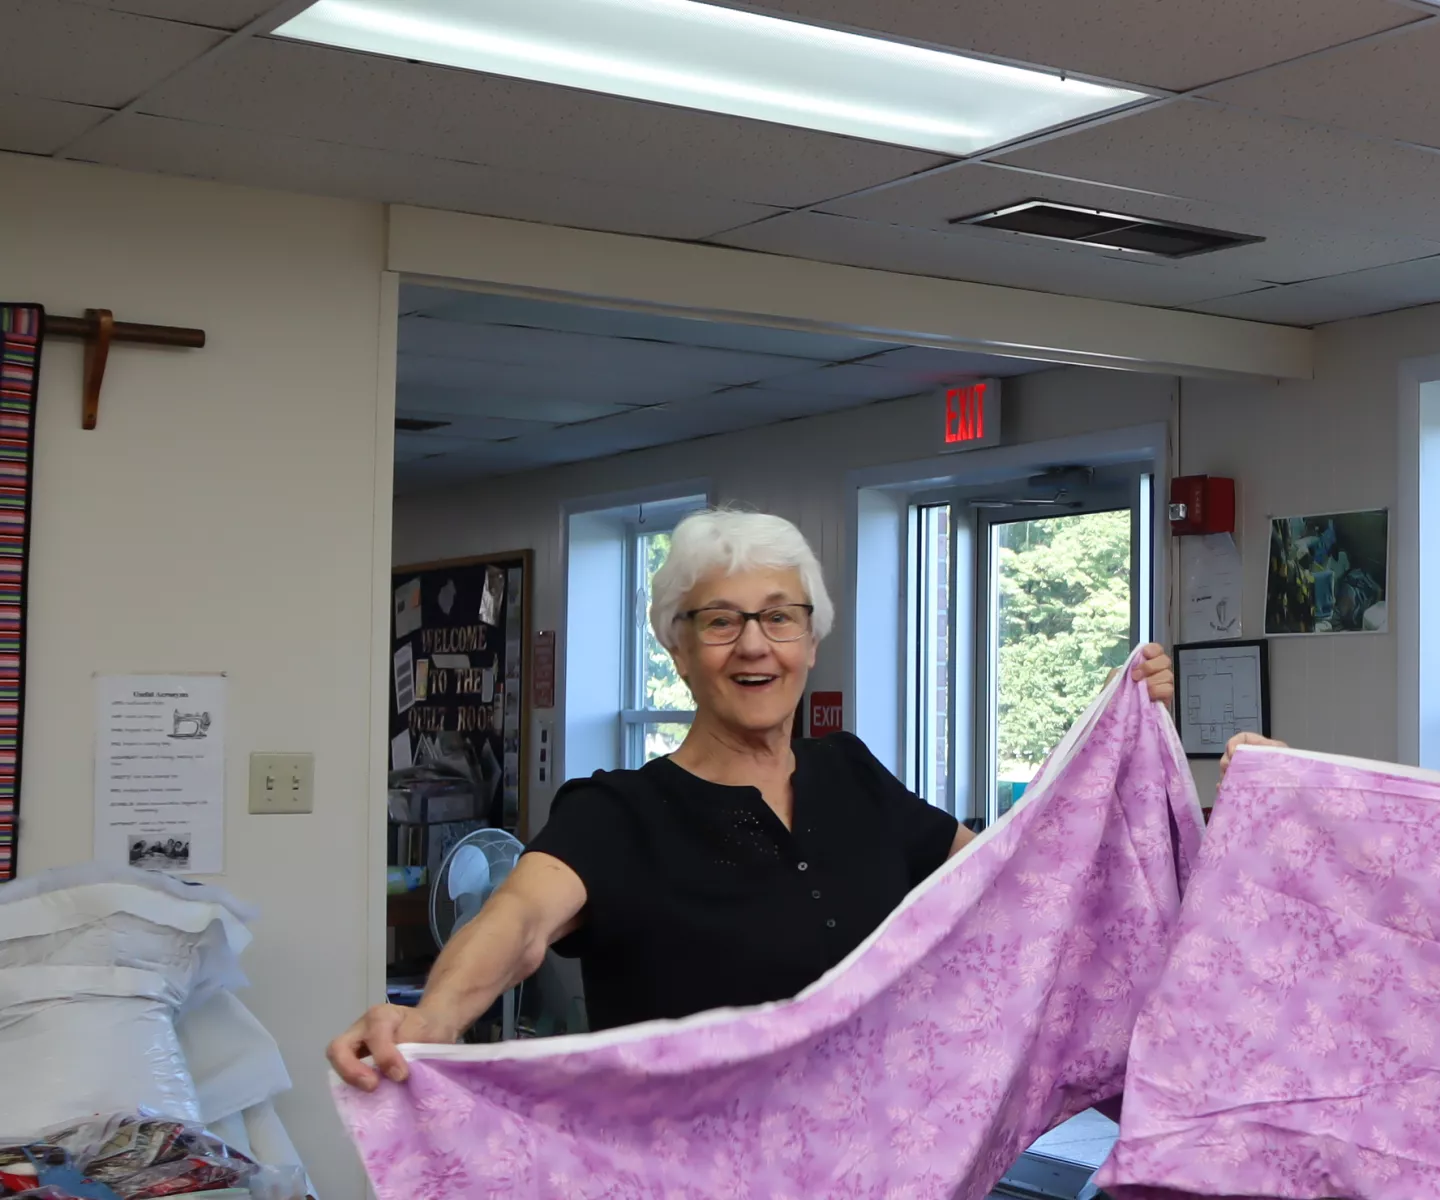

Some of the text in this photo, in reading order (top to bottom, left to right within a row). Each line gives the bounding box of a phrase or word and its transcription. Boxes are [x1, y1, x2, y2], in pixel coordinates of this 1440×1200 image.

[945, 383, 987, 443] EXIT
[421, 625, 488, 653] WELCOME
[430, 668, 481, 694] TO THE
[408, 706, 447, 735] QUILT
[813, 705, 842, 727] EXIT
